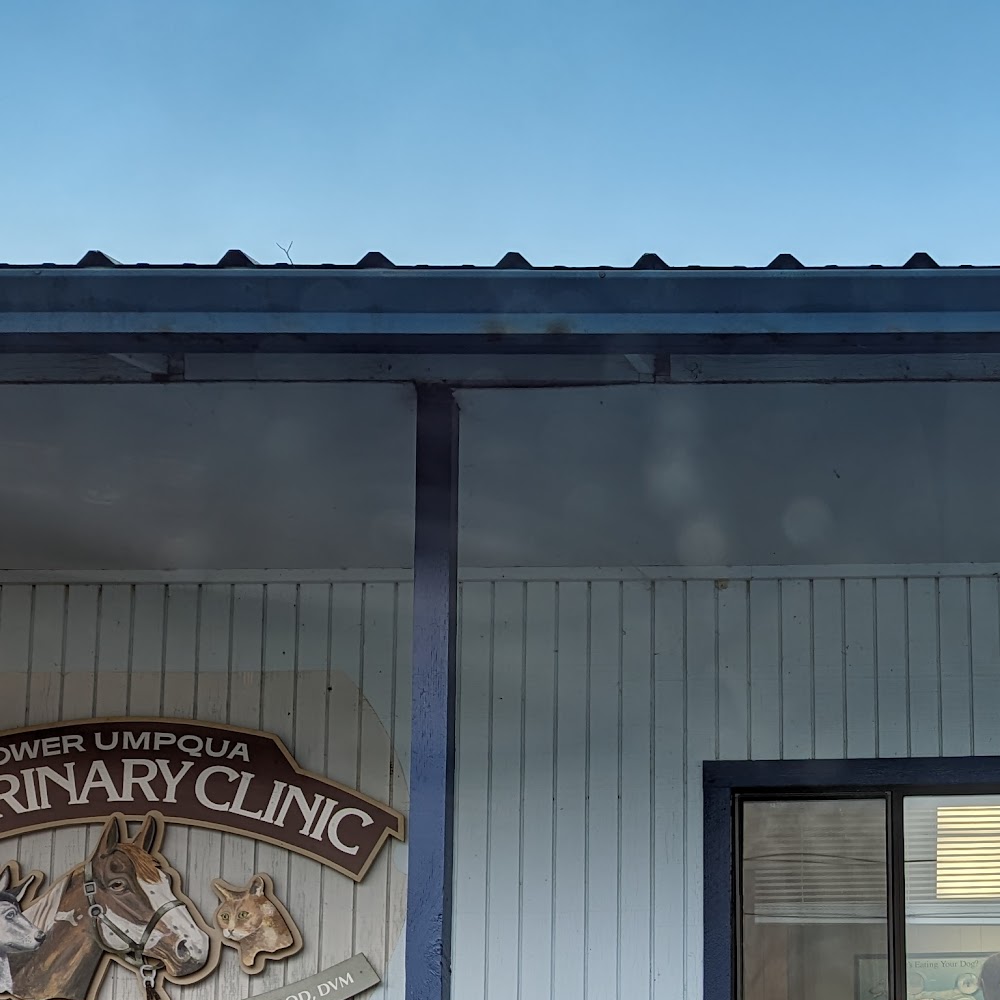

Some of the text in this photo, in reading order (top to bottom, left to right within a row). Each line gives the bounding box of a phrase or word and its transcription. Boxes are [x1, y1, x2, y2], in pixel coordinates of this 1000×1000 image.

[94, 731, 250, 762] UMPQUA
[194, 765, 374, 856] CLINIC
[914, 961, 939, 969] Eating
[941, 960, 958, 968] Your
[960, 960, 979, 969] Dog?
[317, 972, 354, 997] DVM
